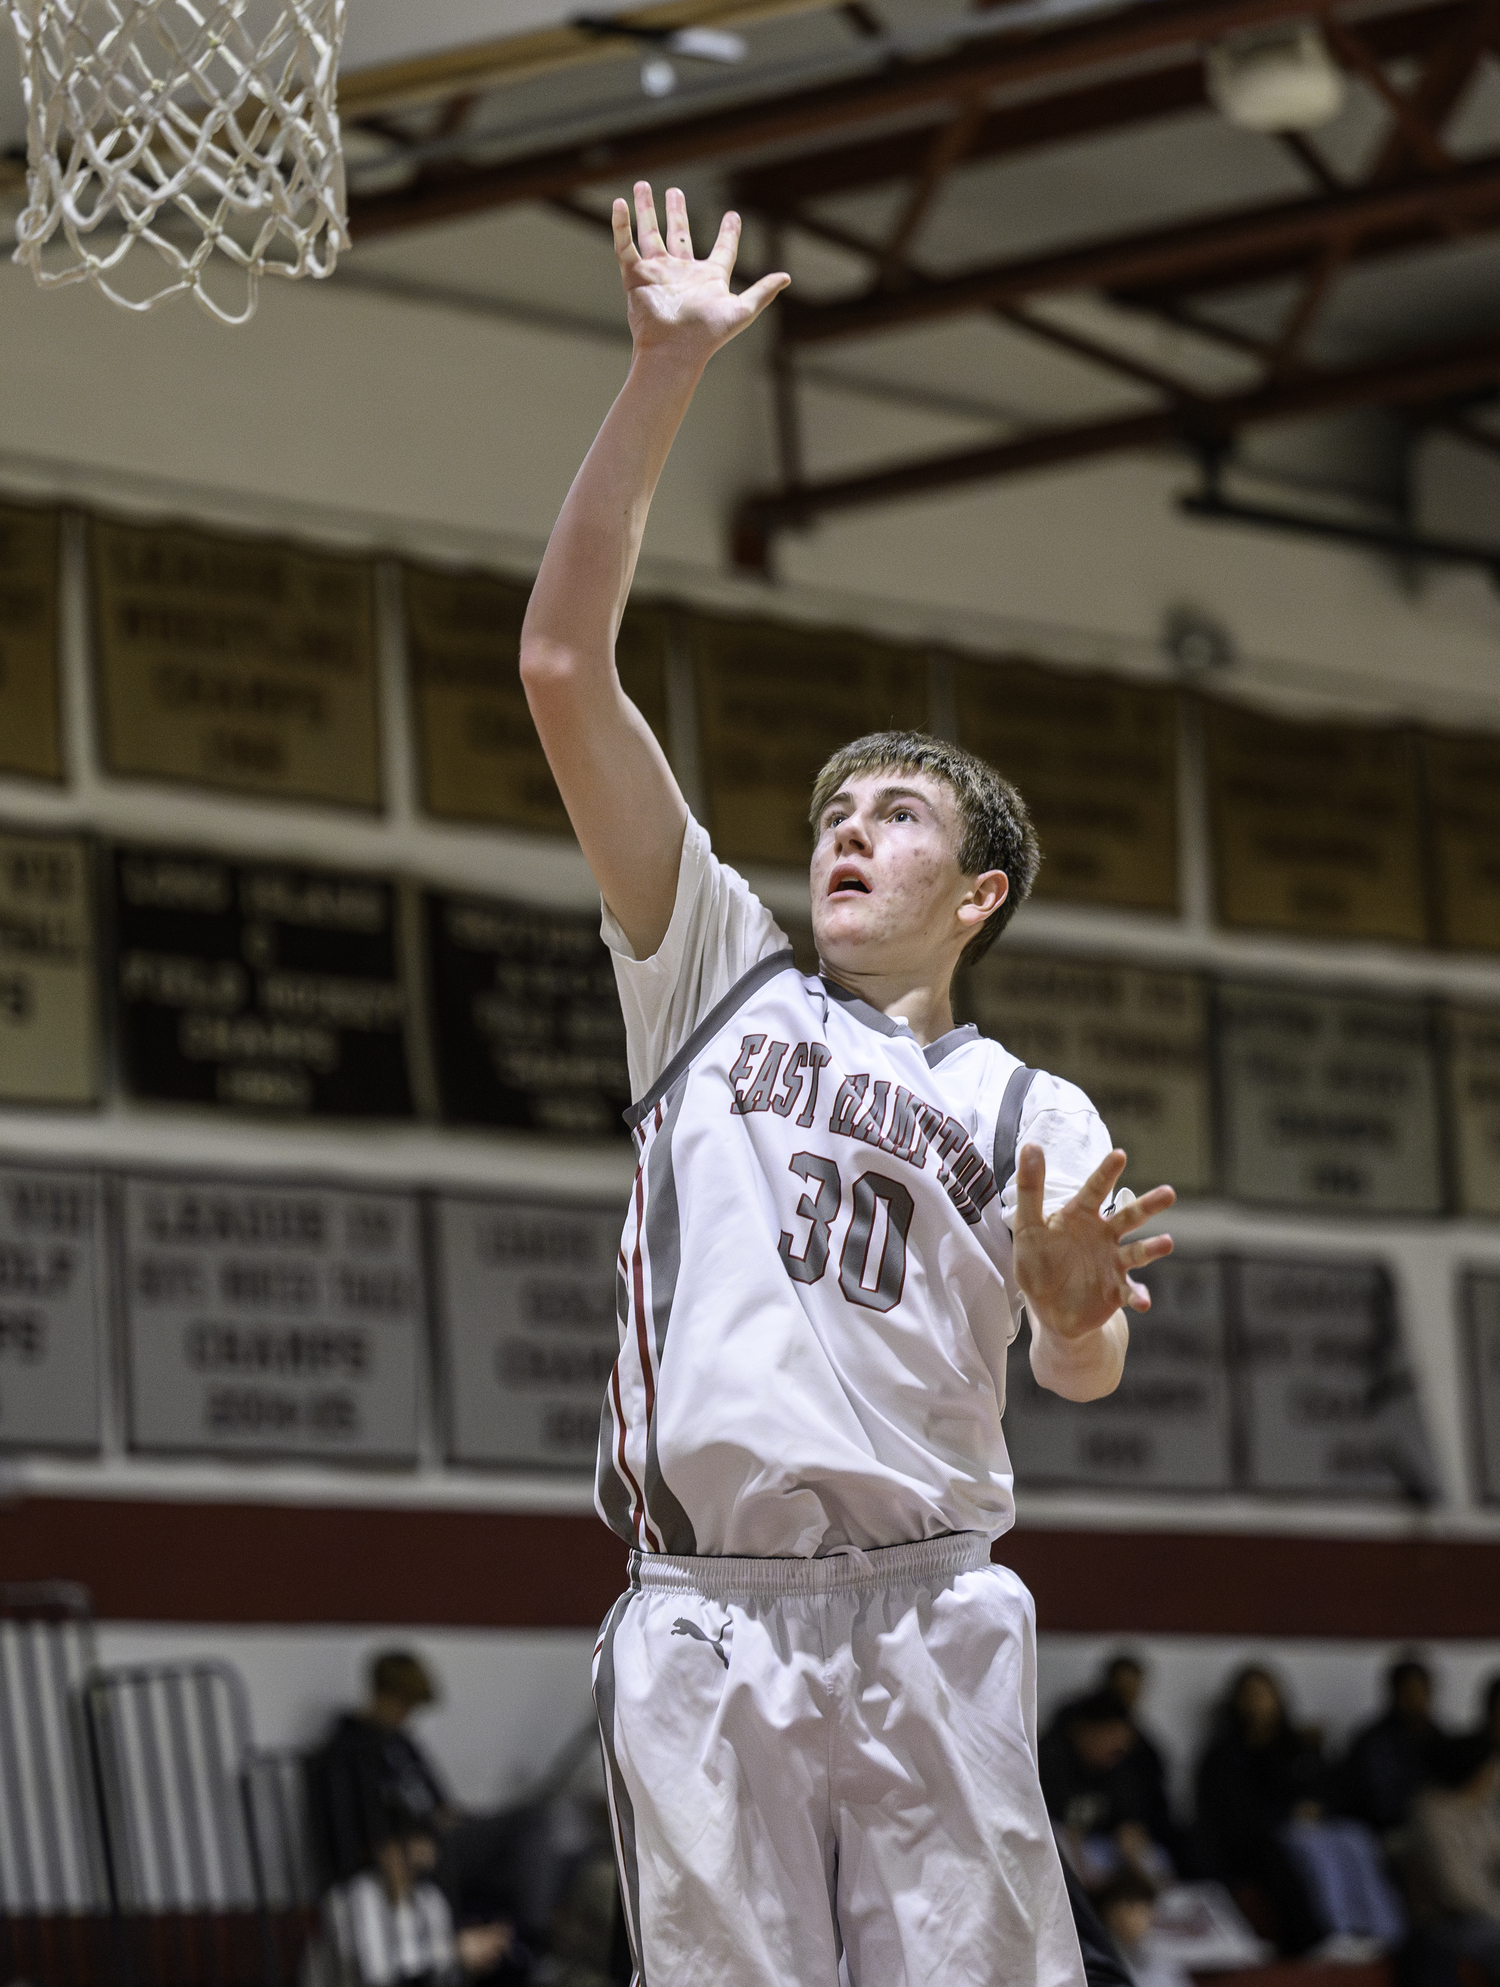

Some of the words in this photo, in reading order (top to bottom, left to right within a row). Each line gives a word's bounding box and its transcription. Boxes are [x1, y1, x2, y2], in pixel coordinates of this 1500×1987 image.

[729, 1034, 832, 1128] EAST
[829, 1073, 999, 1225] HAMPTON
[777, 1151, 915, 1313] 30
